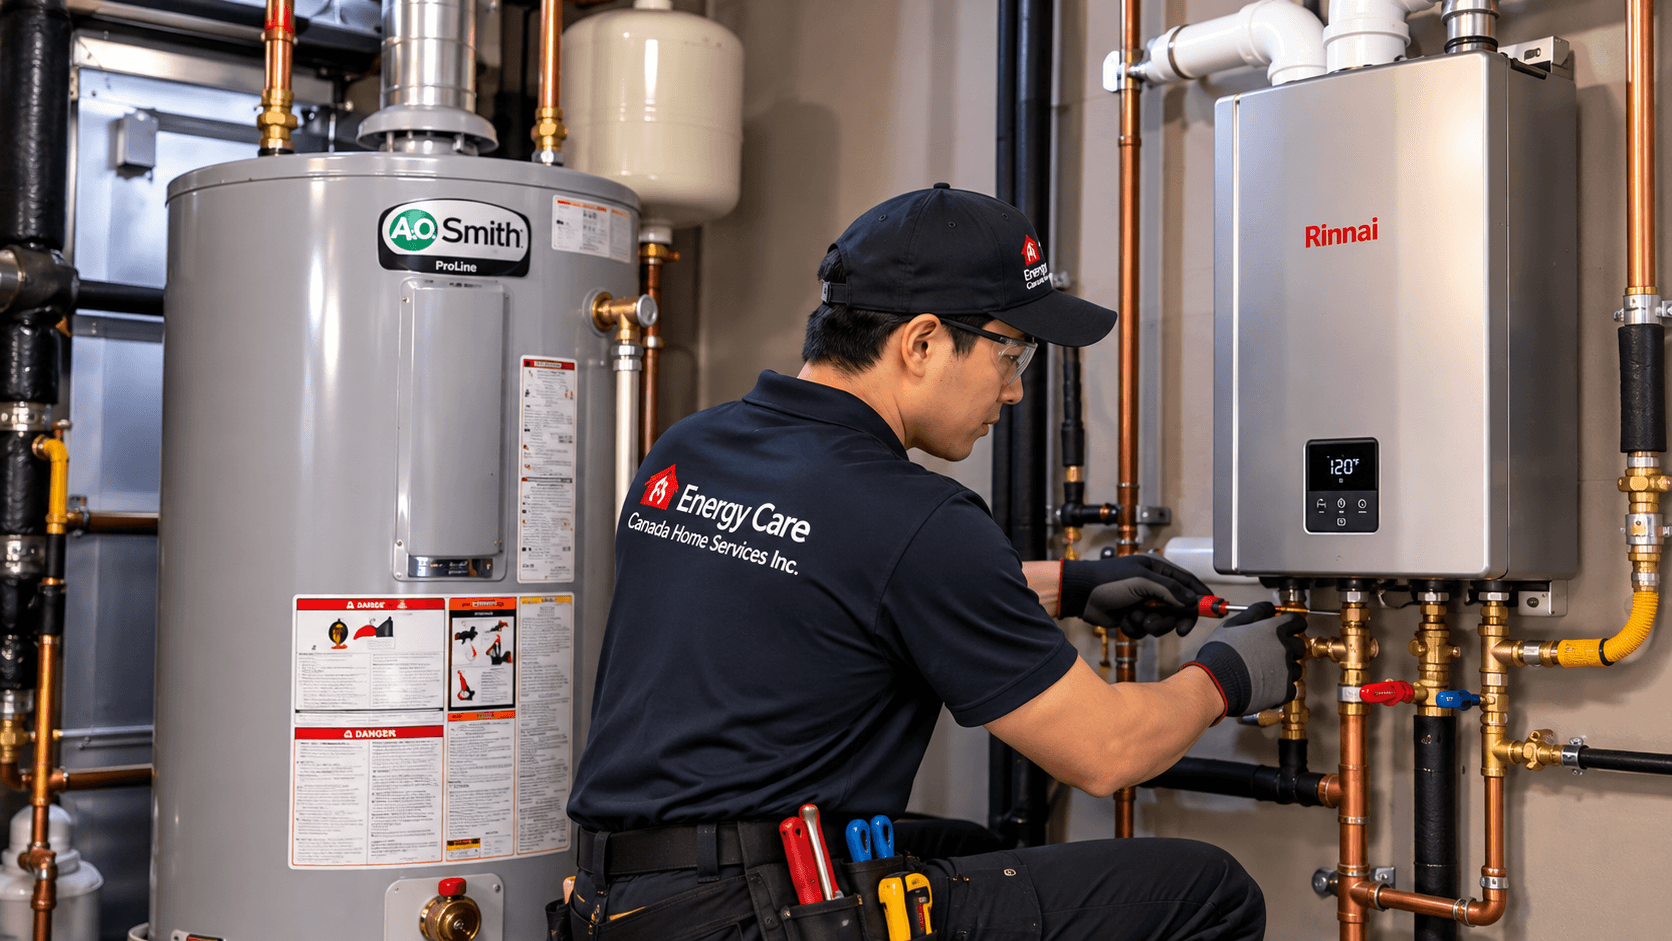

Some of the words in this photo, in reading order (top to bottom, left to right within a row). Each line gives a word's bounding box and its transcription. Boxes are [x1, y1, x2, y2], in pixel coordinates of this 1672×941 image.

[442, 217, 521, 249] Smith
[1305, 216, 1378, 249] Rinnai
[435, 260, 477, 272] ProLine
[676, 483, 752, 533] Energy
[752, 502, 811, 543] Care
[627, 511, 671, 539] Canada
[670, 523, 709, 549] Home
[709, 534, 768, 566] Services
[769, 549, 799, 576] Inc.
